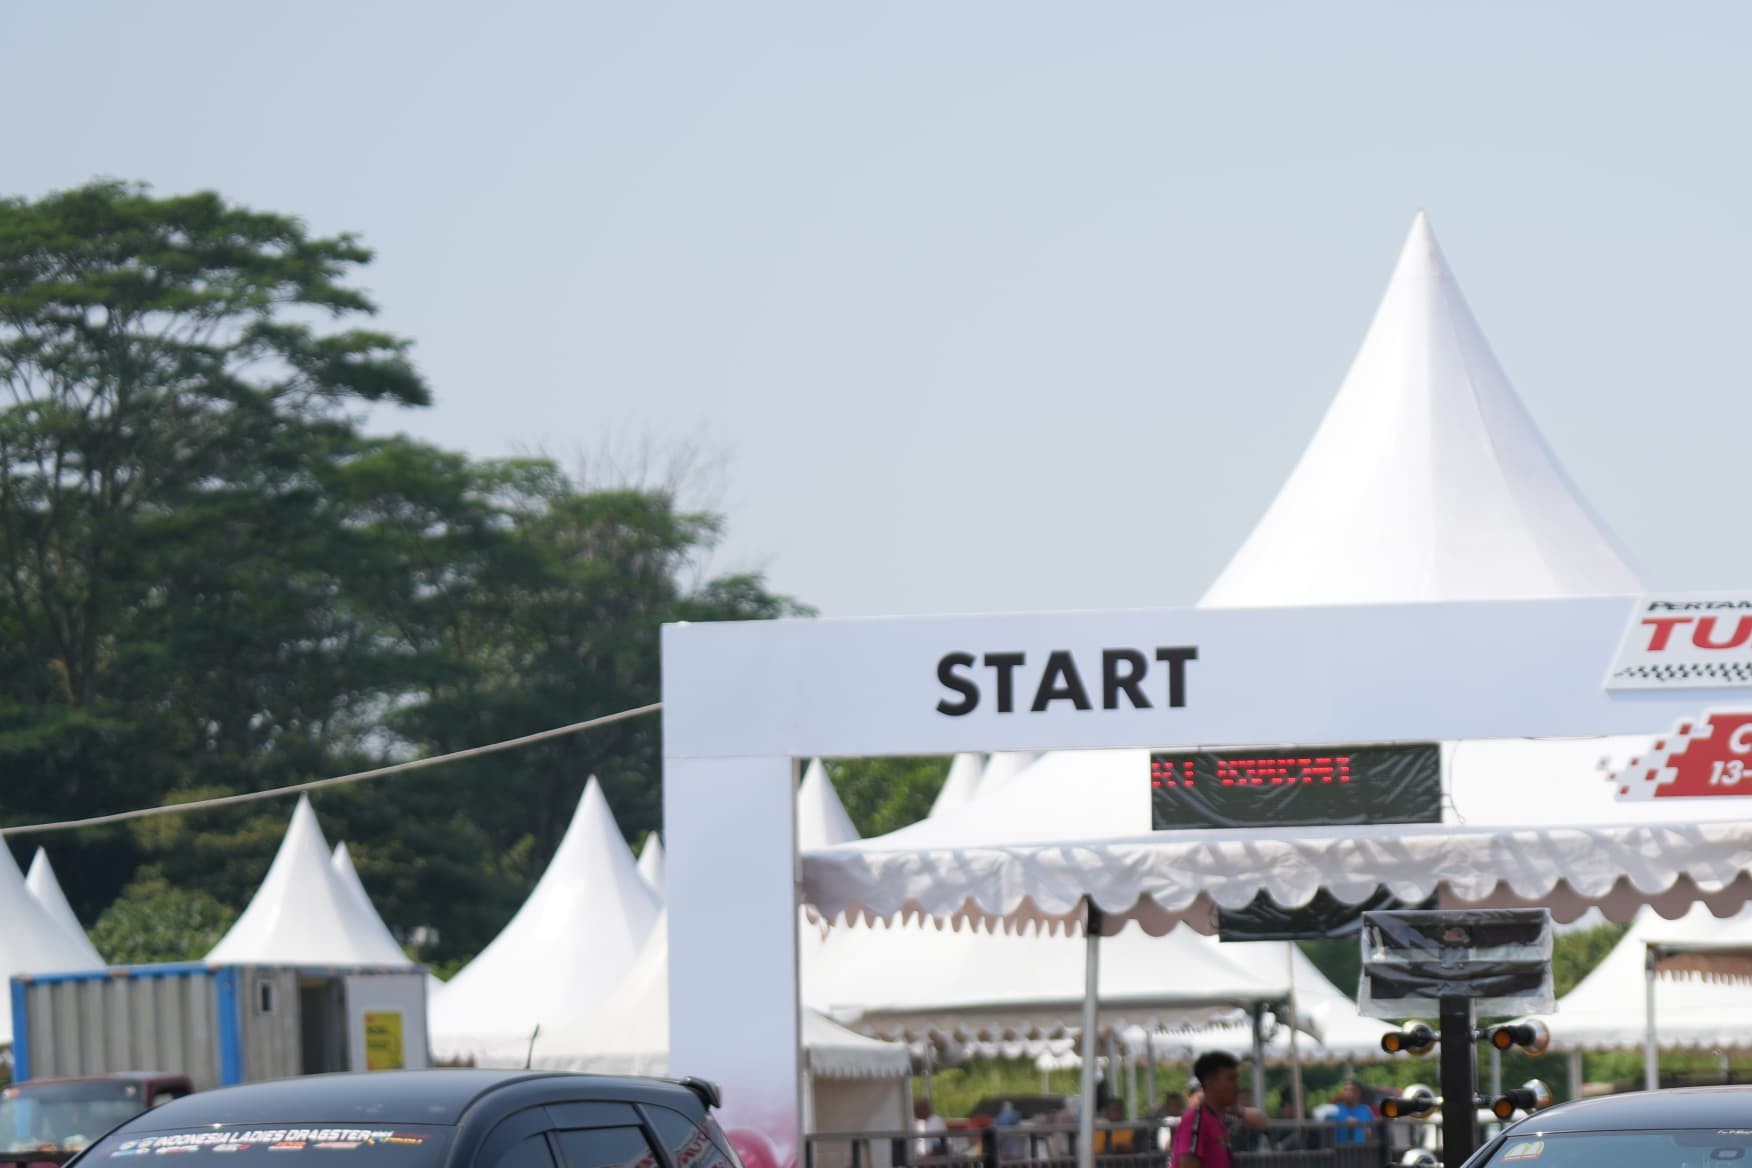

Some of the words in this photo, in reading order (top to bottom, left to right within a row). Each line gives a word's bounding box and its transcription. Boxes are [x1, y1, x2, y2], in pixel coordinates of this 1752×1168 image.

[935, 646, 1199, 717] START
[228, 1129, 287, 1144] LADIES
[285, 1128, 372, 1142] DRAGSTER
